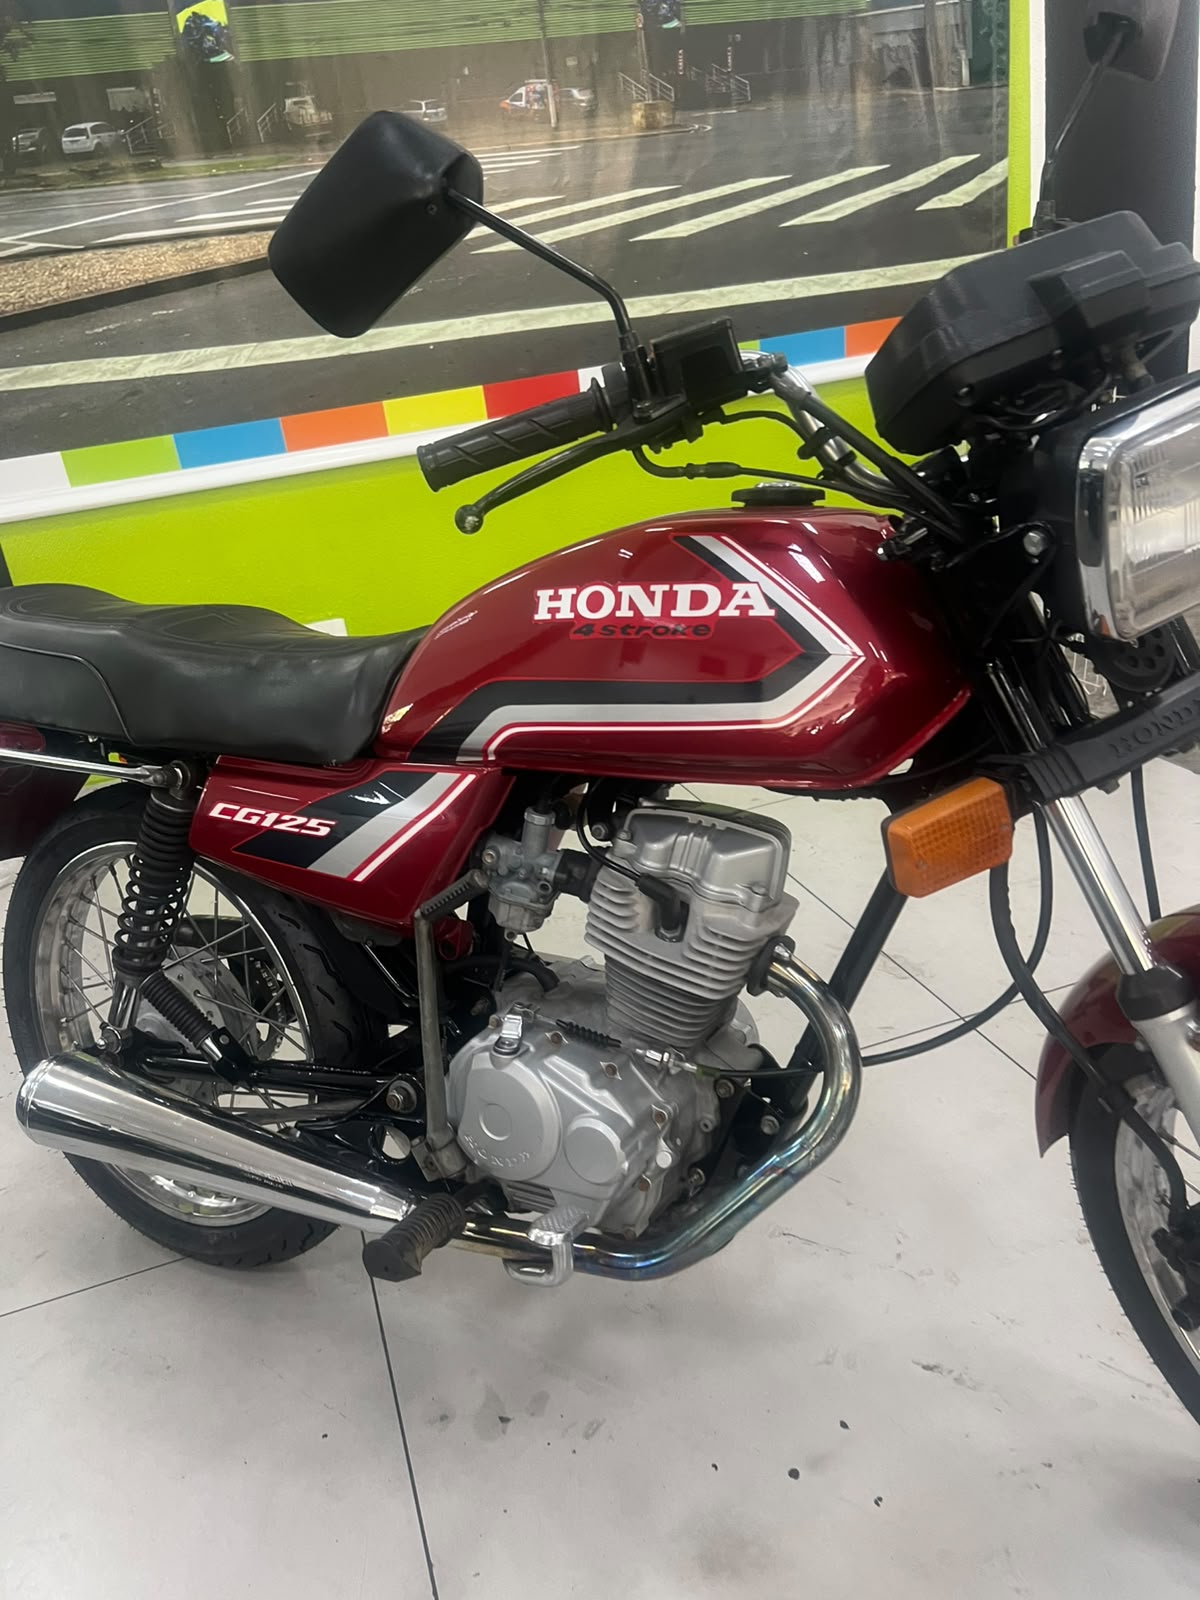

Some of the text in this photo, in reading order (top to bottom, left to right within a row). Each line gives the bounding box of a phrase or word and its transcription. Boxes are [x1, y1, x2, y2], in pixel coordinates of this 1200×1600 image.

[533, 583, 776, 621] HONDA
[1107, 698, 1200, 759] HOND
[208, 802, 337, 837] CG125
